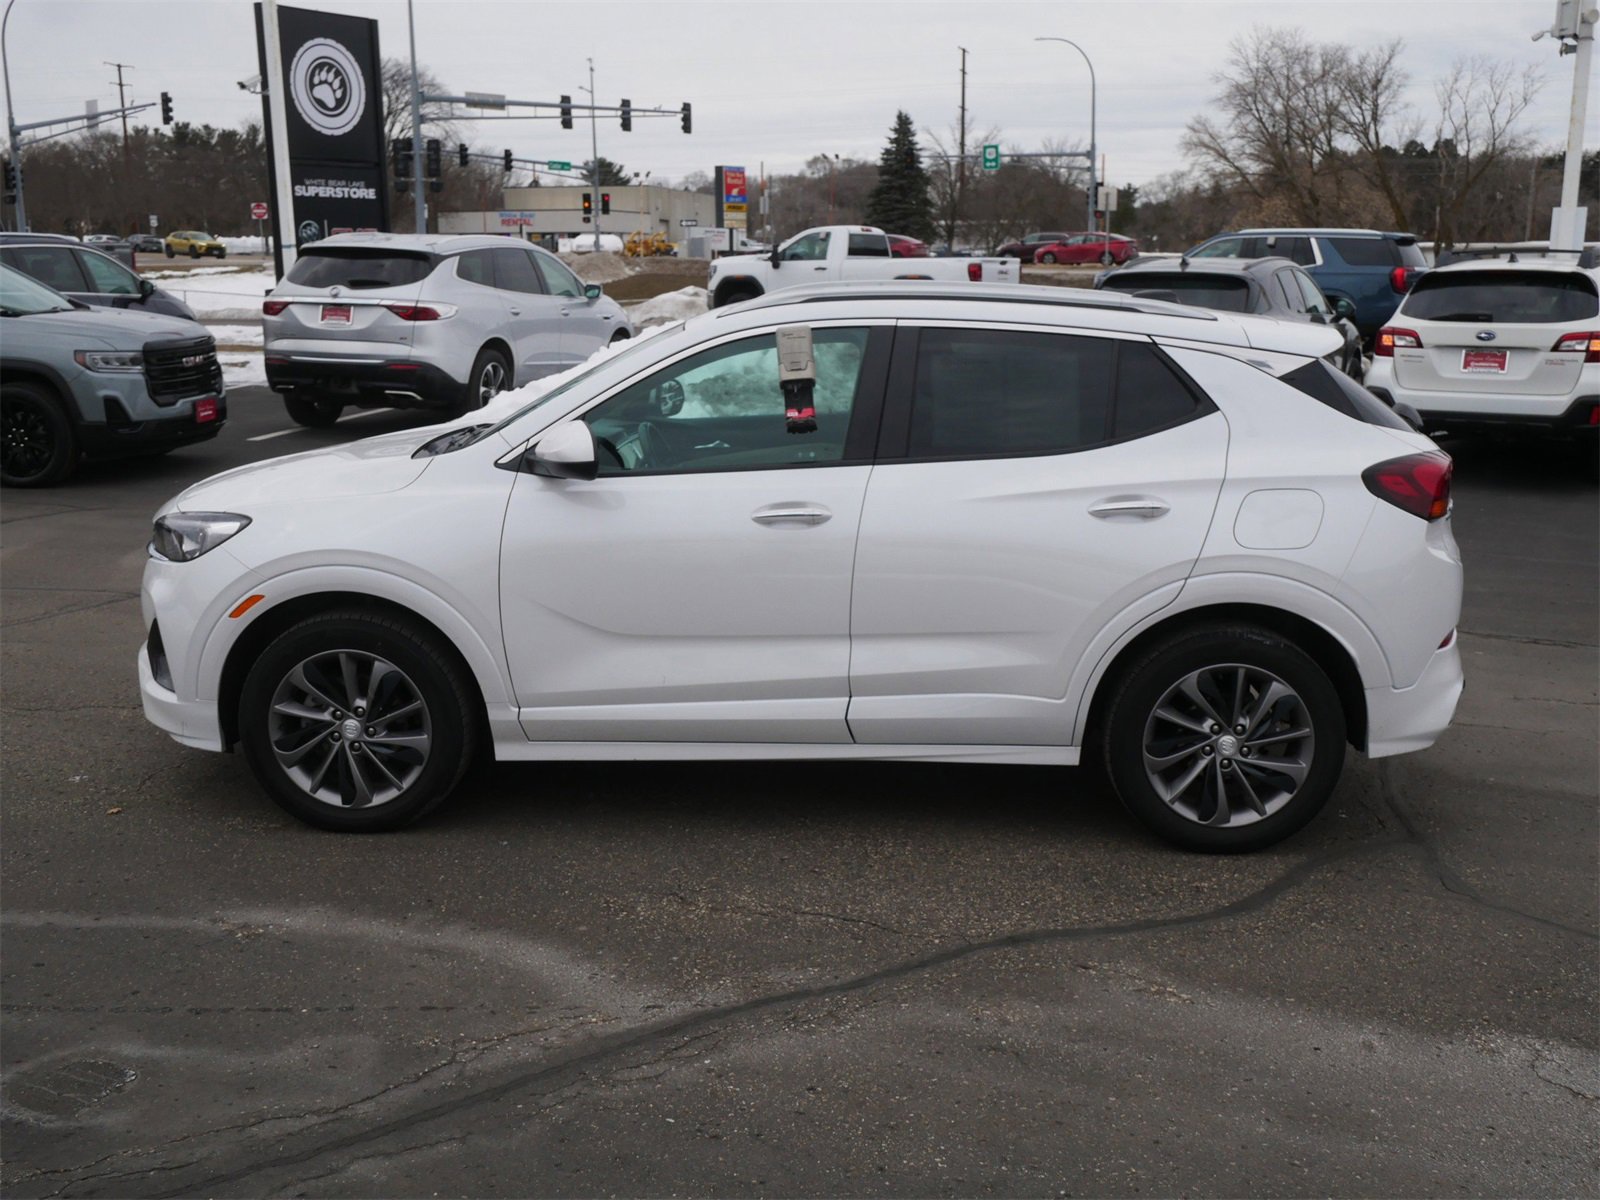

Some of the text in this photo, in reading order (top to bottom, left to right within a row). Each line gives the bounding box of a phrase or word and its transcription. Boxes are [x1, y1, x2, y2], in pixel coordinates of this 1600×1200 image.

[304, 178, 366, 188] WHITE BEAR LAKE
[294, 184, 377, 199] SUPERSTORE
[501, 218, 534, 226] RENTAL
